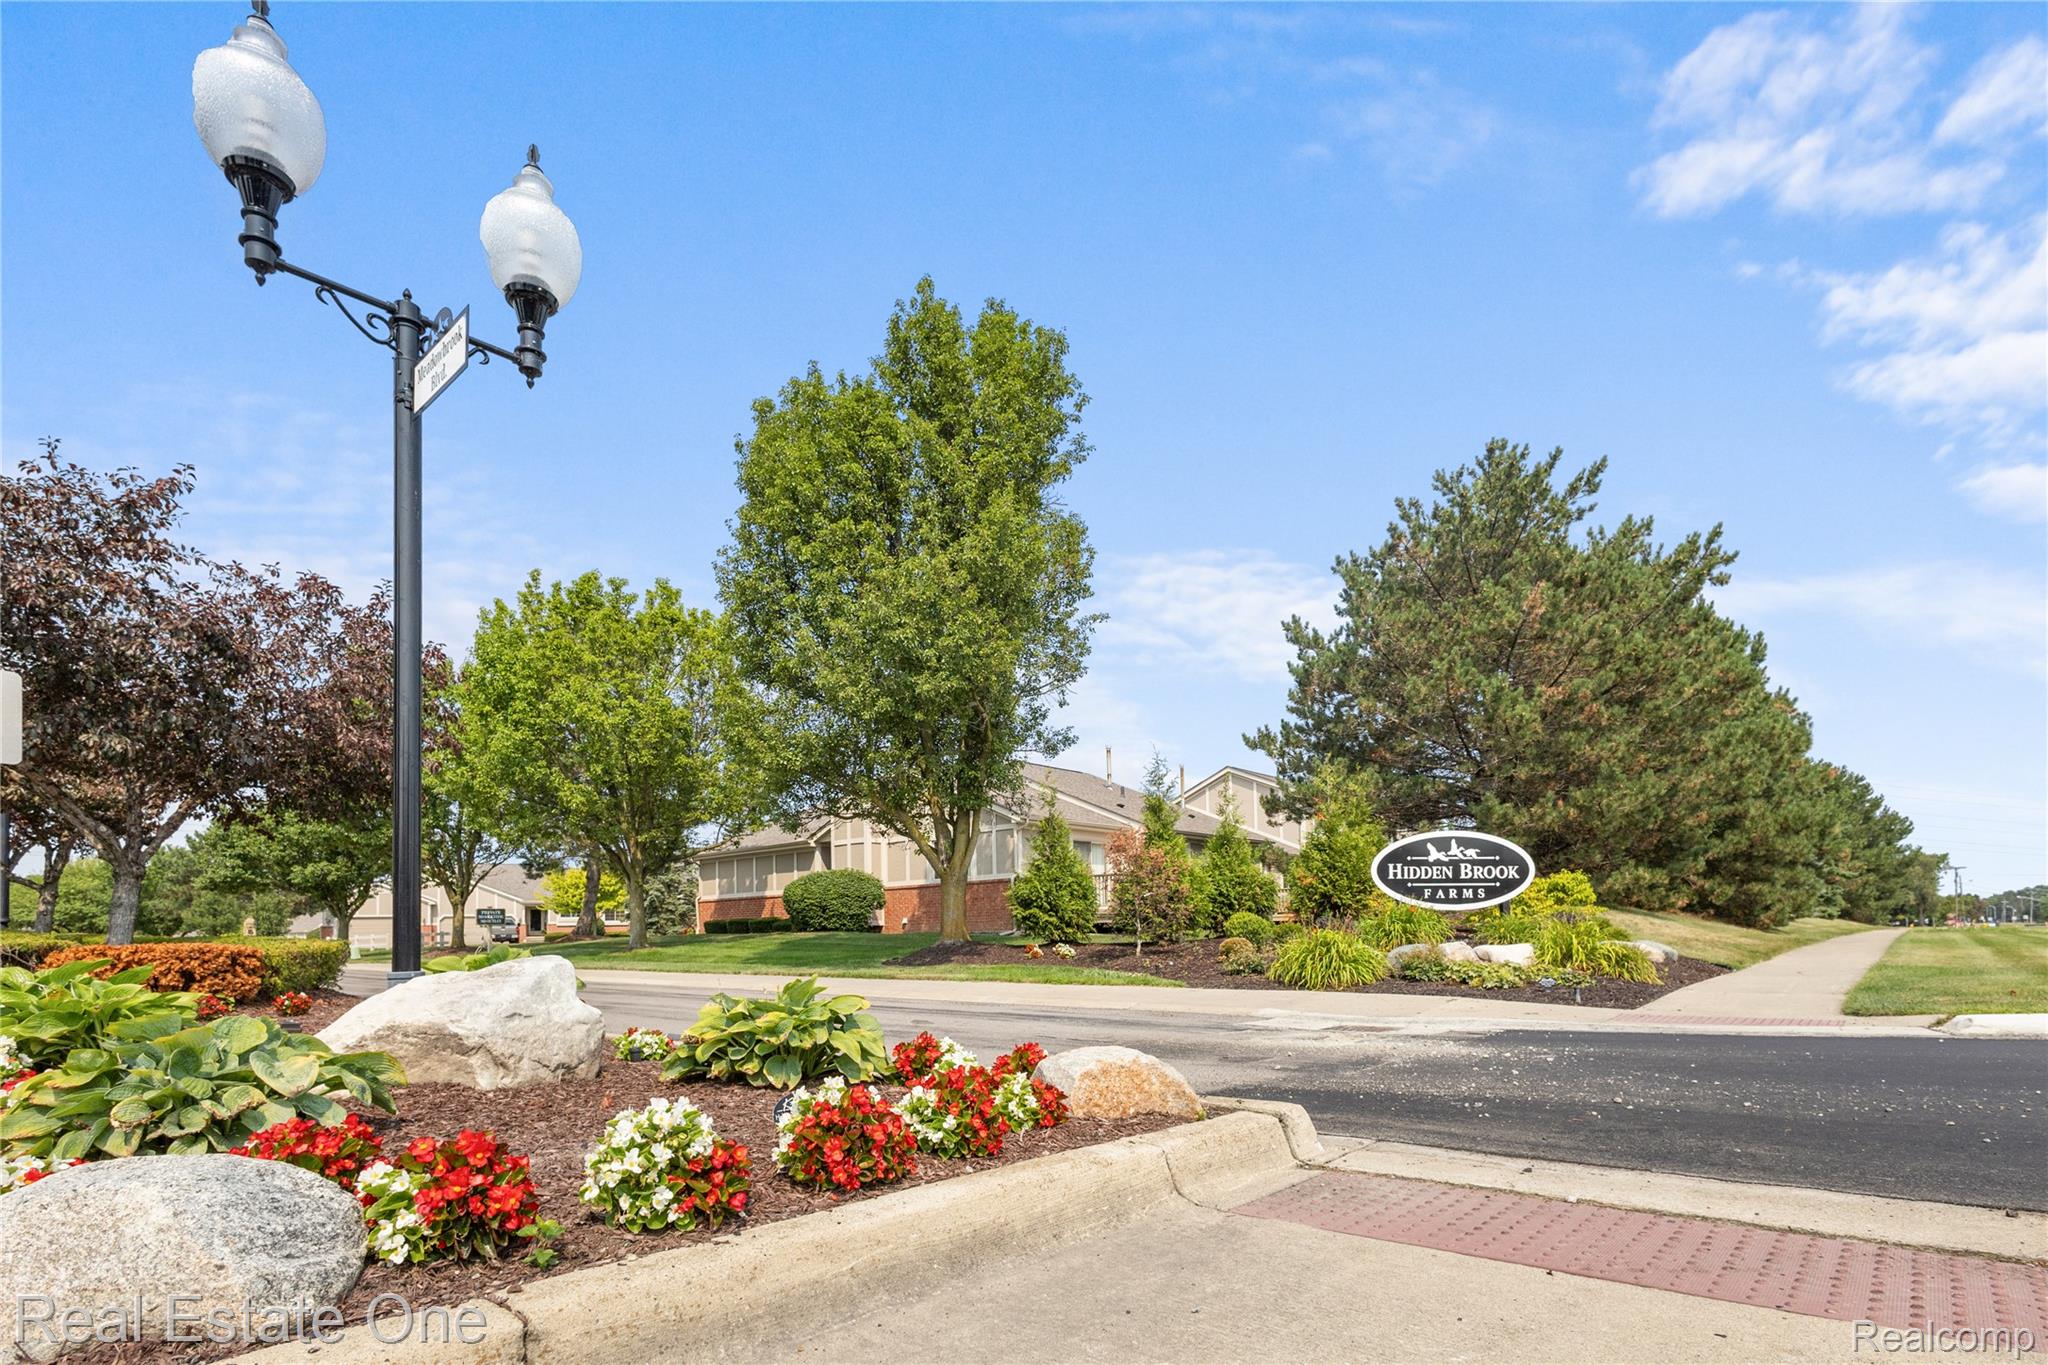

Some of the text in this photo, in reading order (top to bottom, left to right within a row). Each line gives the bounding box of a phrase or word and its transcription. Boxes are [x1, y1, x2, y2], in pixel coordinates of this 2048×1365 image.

[1387, 863, 1520, 879] HIDDEN BROOK
[1424, 888, 1486, 899] FARMS
